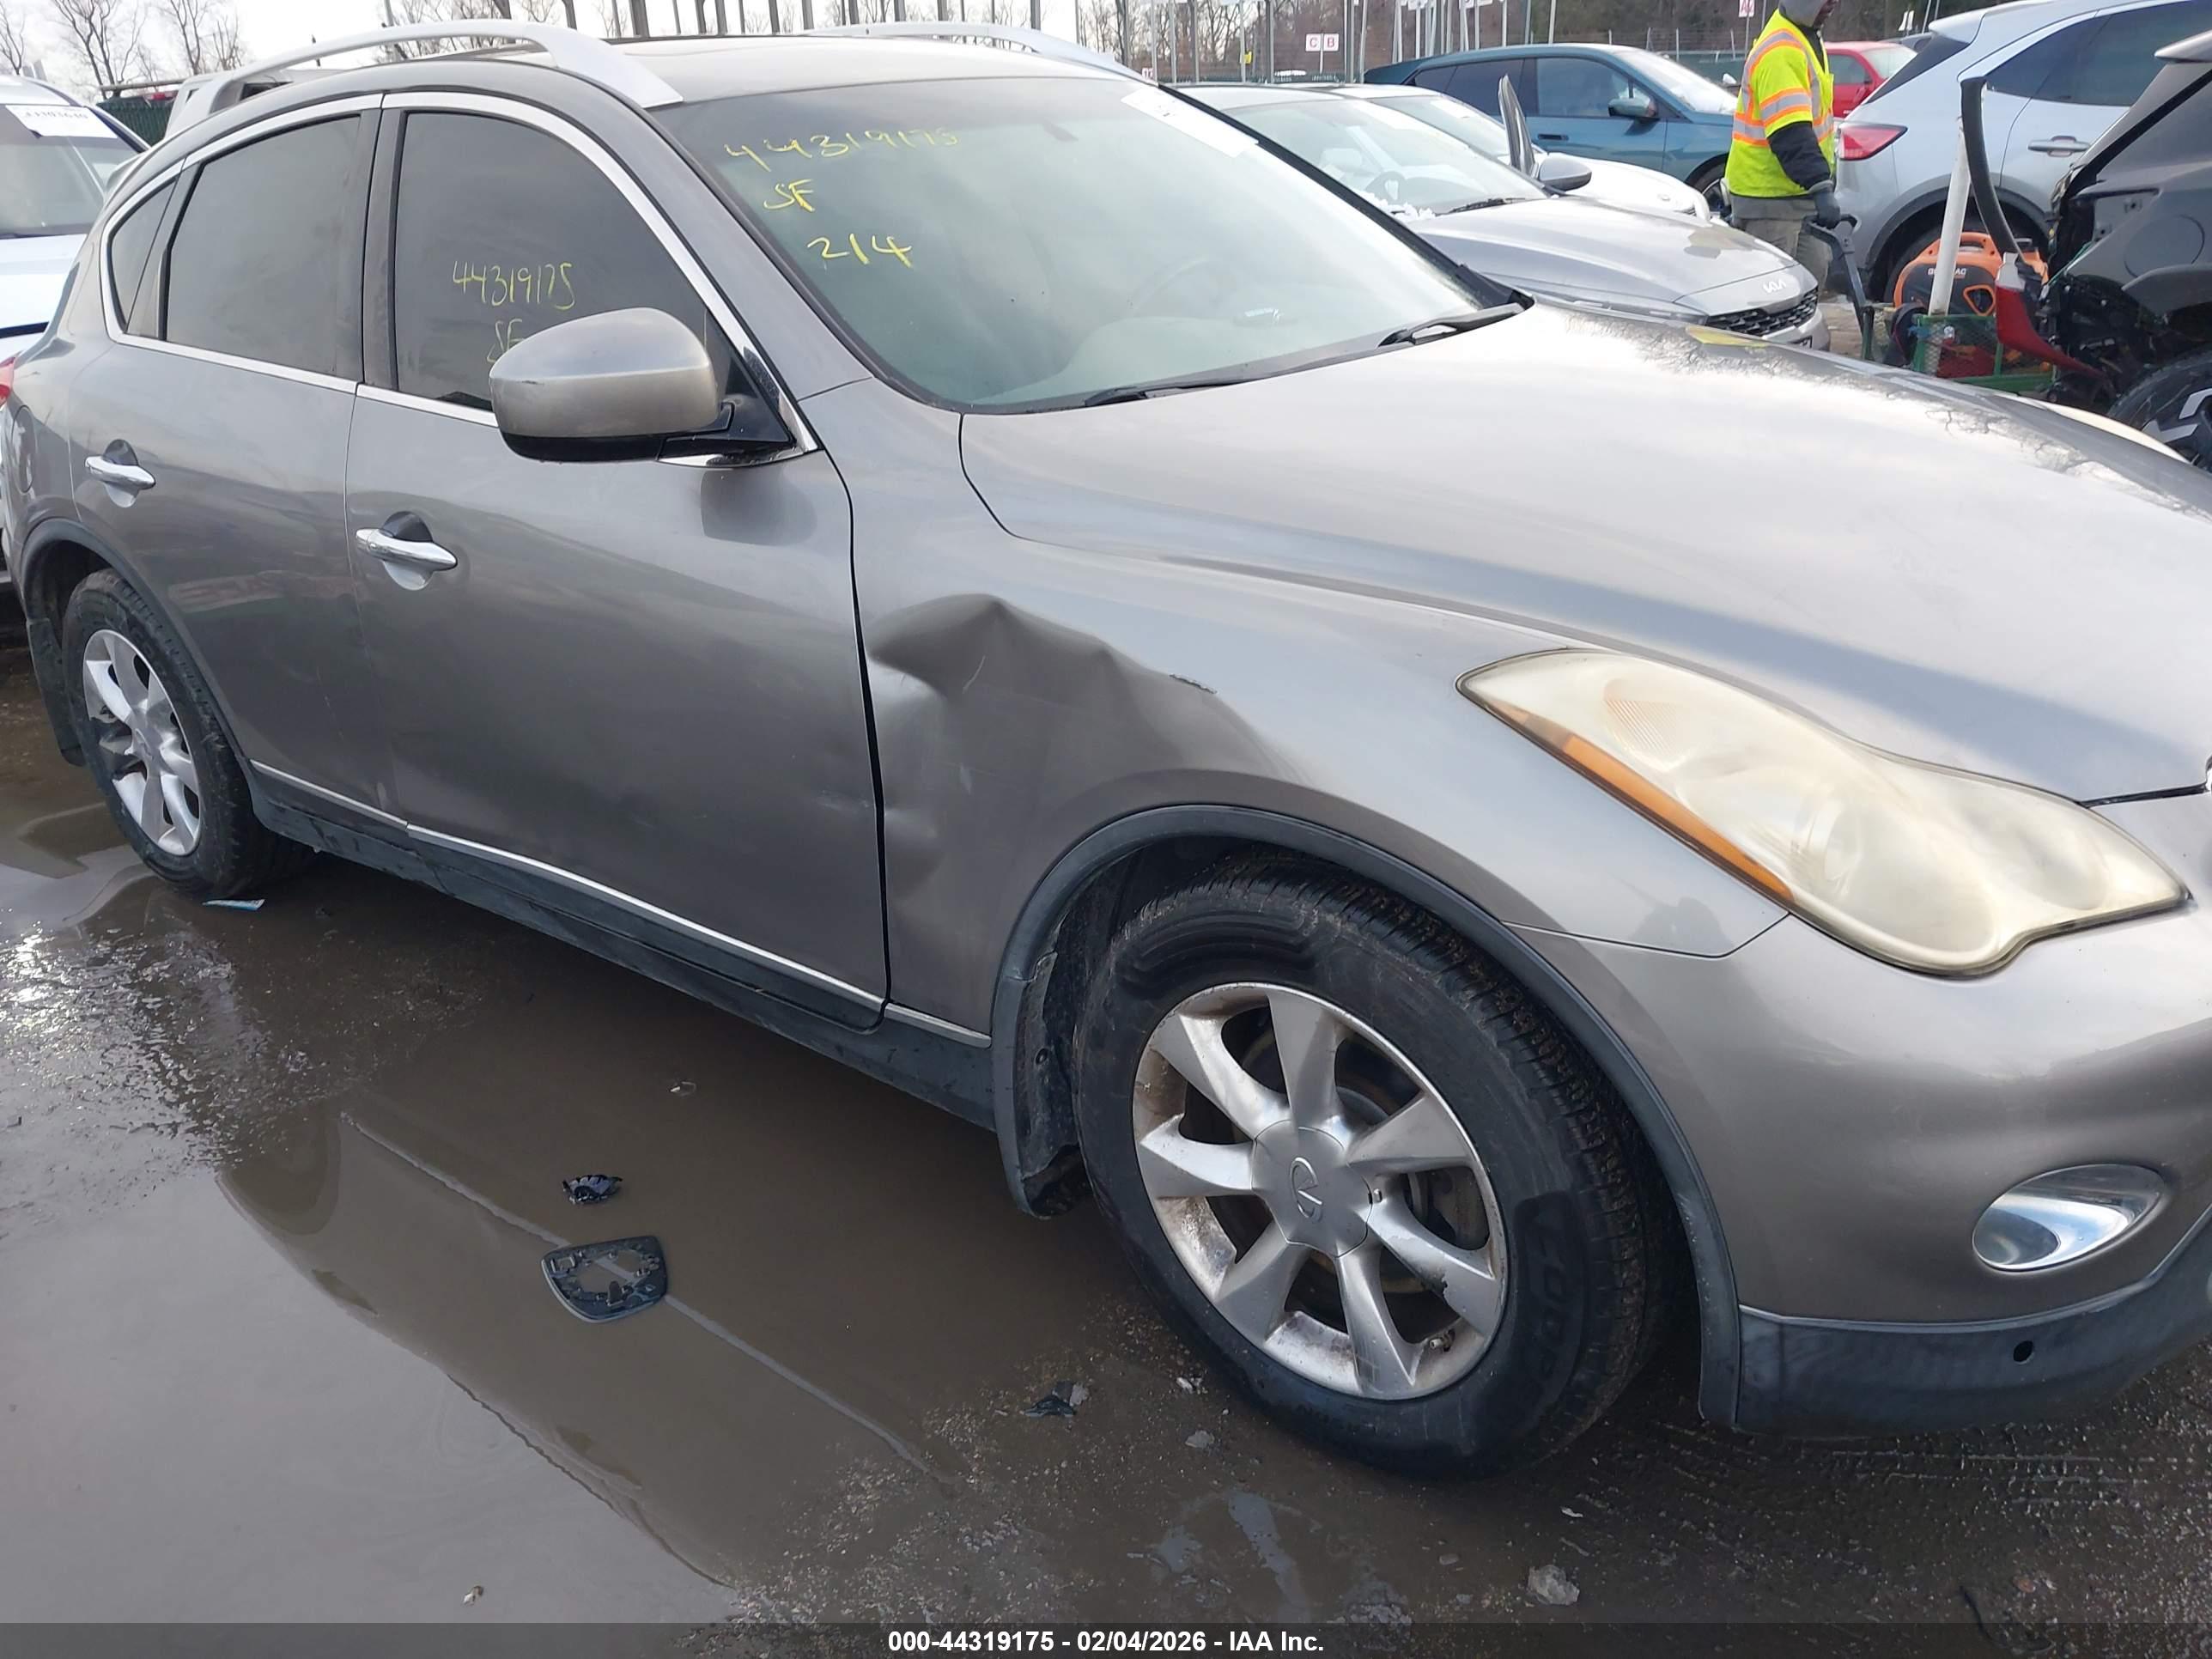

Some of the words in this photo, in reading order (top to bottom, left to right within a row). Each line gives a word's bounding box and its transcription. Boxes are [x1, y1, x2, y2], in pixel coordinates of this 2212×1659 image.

[724, 128, 958, 172] 44319175
[763, 179, 815, 212] SF
[453, 260, 575, 310] 44319175
